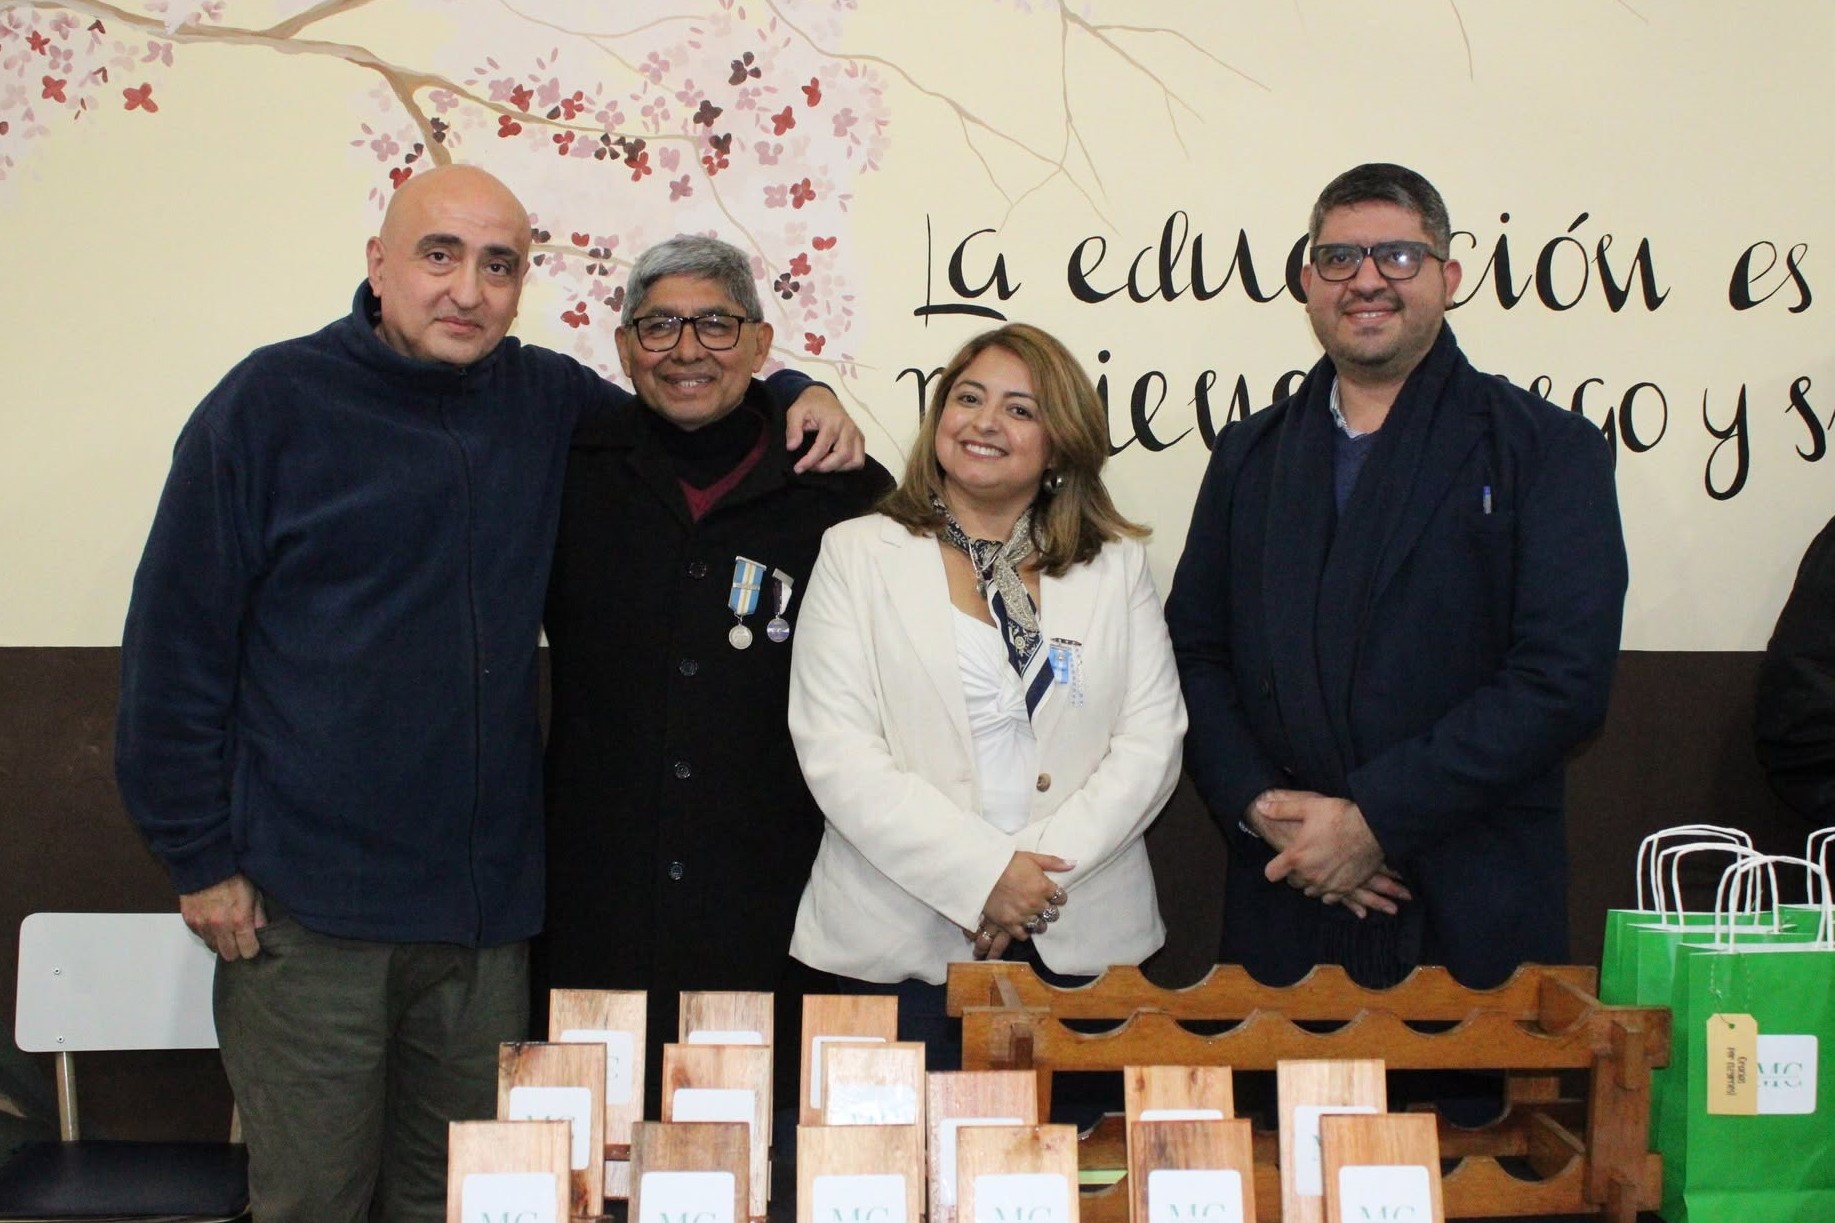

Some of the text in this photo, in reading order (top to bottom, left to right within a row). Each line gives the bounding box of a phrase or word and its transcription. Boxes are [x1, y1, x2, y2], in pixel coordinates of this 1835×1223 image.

[914, 210, 1813, 327] La educción es
[1703, 383, 1750, 500] y
